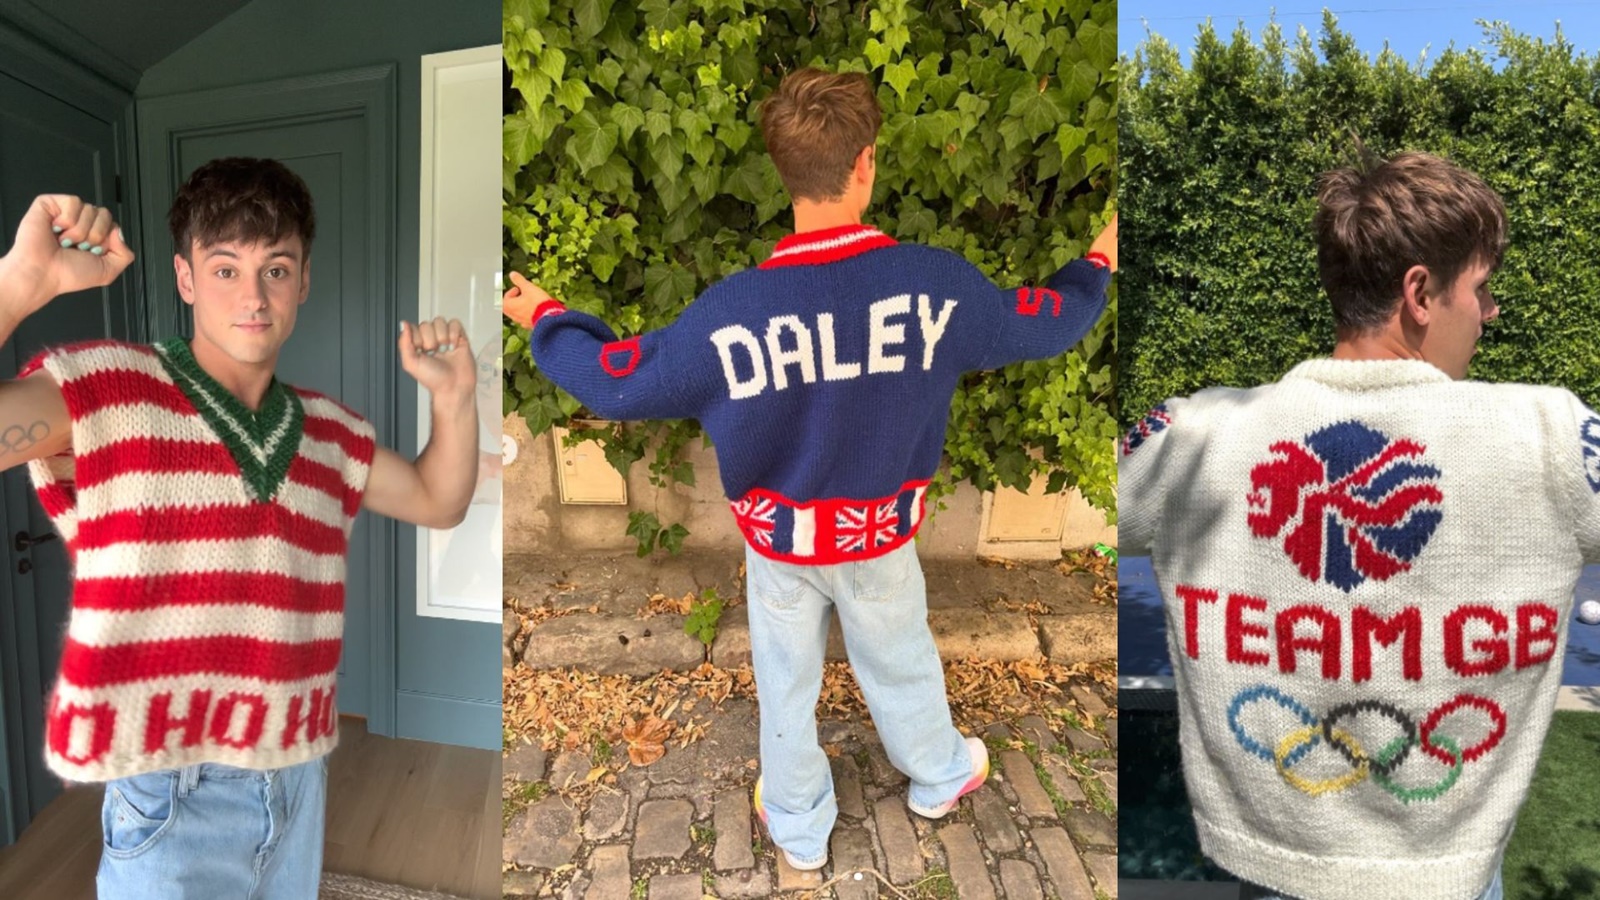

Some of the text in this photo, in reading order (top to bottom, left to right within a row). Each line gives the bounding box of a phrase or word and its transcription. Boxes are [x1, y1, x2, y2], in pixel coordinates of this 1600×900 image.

[709, 293, 958, 400] DALEY
[1175, 584, 1559, 683] TEAM GB
[143, 687, 270, 755] HO
